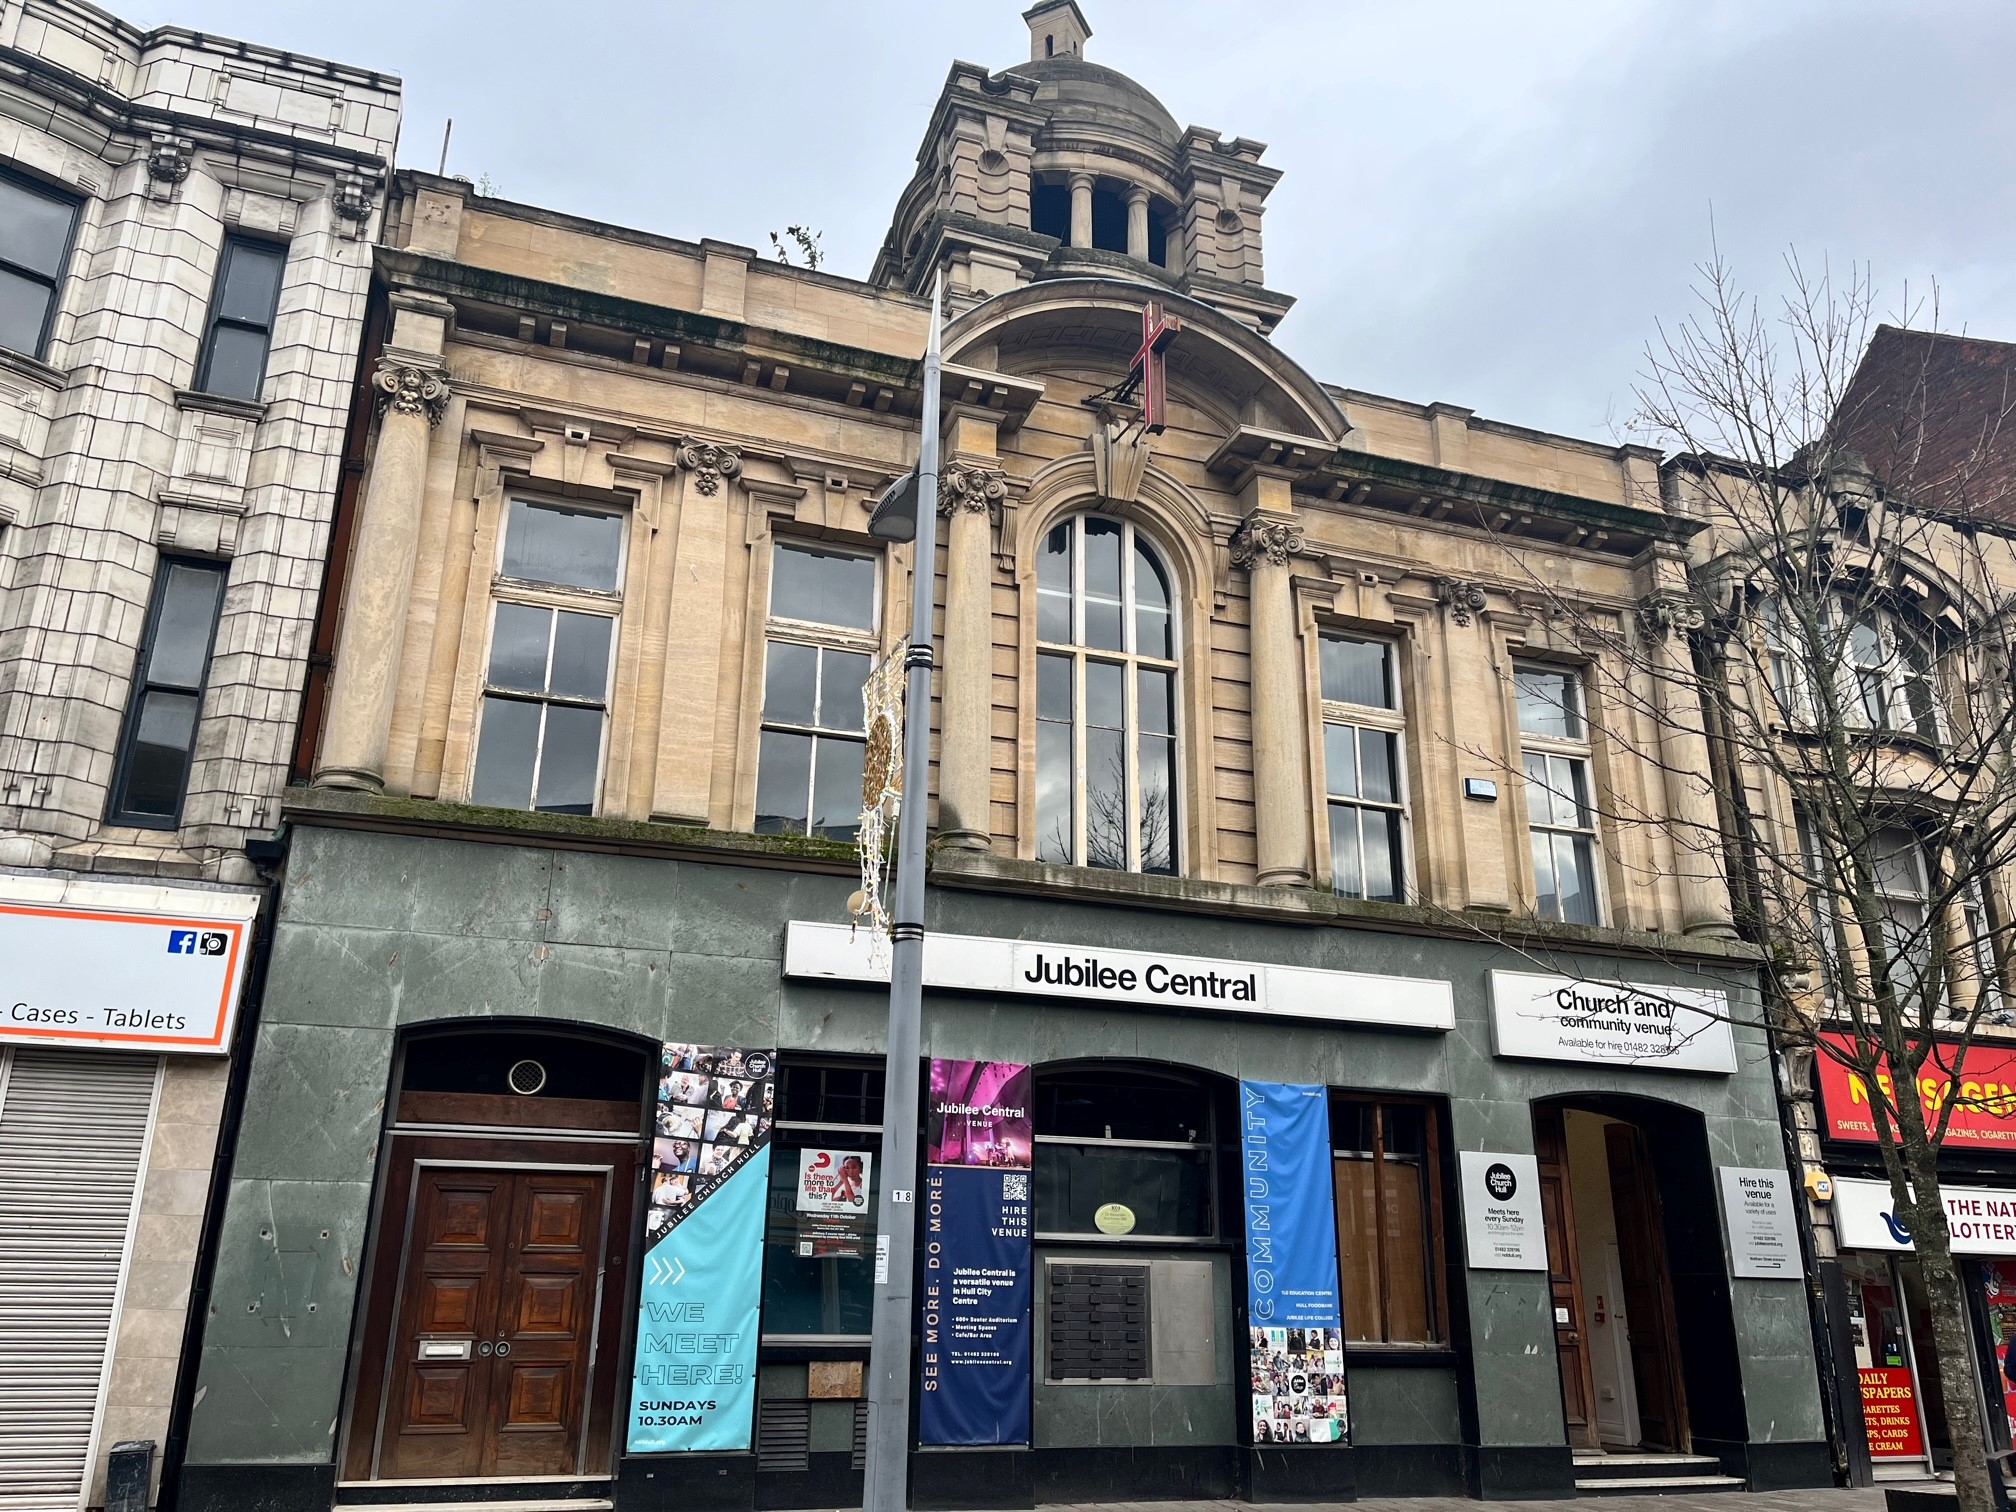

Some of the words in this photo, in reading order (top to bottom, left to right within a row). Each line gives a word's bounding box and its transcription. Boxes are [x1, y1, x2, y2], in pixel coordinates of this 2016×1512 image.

[1025, 954, 1136, 990] Jubilee
[1146, 964, 1256, 1001] Central
[1557, 989, 1629, 1014] Church
[1634, 1001, 1671, 1018] and
[12, 1002, 78, 1024] Cases
[104, 1008, 186, 1030] Tablets
[1560, 1016, 1632, 1034] community
[1634, 1022, 1671, 1035] venue
[1558, 1037, 1594, 1048] Available
[1596, 1040, 1606, 1050] for
[1608, 1042, 1622, 1050] hire
[1624, 1042, 1648, 1052] 01482
[937, 1102, 979, 1115] Jubilee
[982, 1104, 1024, 1118] Central
[966, 1120, 992, 1128] VENUE
[1837, 1120, 1870, 1132] SWEETS,
[1490, 1172, 1511, 1180] Jubilee
[1739, 1177, 1757, 1187] Hire
[1758, 1178, 1774, 1188] this
[656, 1202, 694, 1239] JUBILEE
[698, 1166, 734, 1200] CHURCH
[736, 1144, 760, 1165] HULL
[1745, 1190, 1772, 1199] venue
[930, 1171, 942, 1232] MORE.
[1246, 1088, 1274, 1320] COMMUNITY
[1947, 1200, 1982, 1216] THE
[1002, 1206, 1027, 1215] HIRE
[1002, 1217, 1027, 1226] THIS
[1502, 1216, 1524, 1224] Sunday
[991, 1228, 1027, 1237] VENUE
[1951, 1222, 2016, 1240] LOTTER
[928, 1242, 940, 1268] DO
[977, 1288, 992, 1296] City
[647, 1302, 704, 1322] WE
[926, 1280, 939, 1342] MORE.
[644, 1333, 739, 1353] MEET
[641, 1364, 743, 1386] HERE!
[924, 1353, 938, 1391] SEE
[639, 1400, 716, 1410] SUNDAYS
[638, 1416, 702, 1426] 10.30AM
[1880, 1417, 1910, 1425] DRINKS
[1882, 1429, 1908, 1438] CARDS
[1875, 1442, 1903, 1450] CREAM
